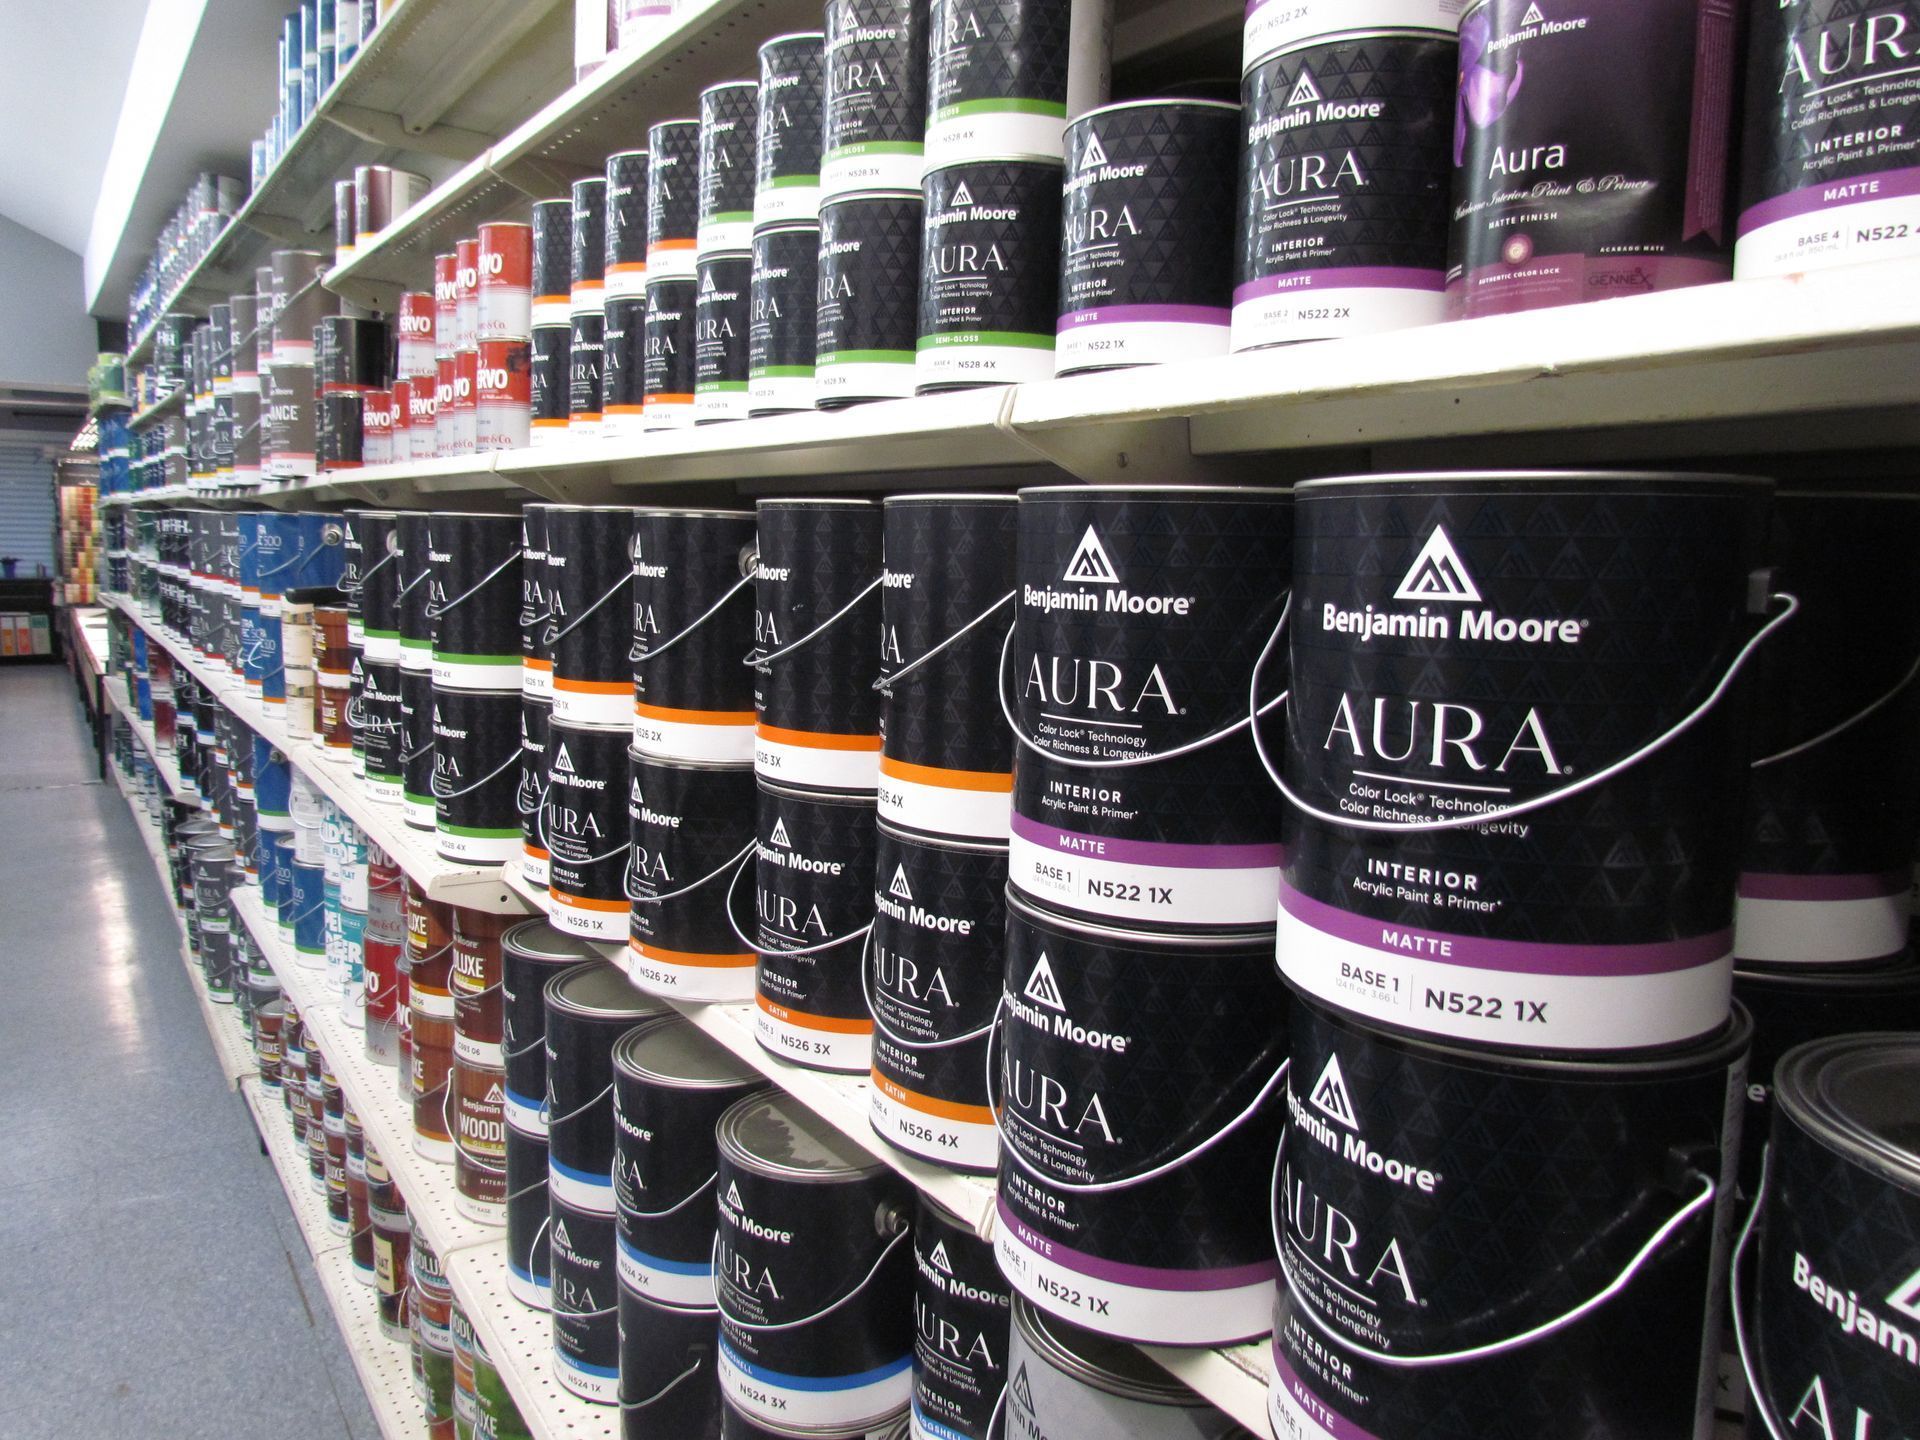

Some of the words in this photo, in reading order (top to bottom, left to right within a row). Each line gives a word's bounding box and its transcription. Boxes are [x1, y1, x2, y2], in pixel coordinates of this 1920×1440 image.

[856, 28, 896, 43] Moore
[1488, 27, 1537, 53] Benjamin
[1541, 18, 1586, 36] Moore
[1778, 13, 1920, 94] AUR
[1799, 100, 1825, 114] Color
[1827, 90, 1853, 105] Lock
[1818, 103, 1865, 121] Richness
[1249, 109, 1310, 144] Benjamin
[1316, 103, 1380, 122] Moore
[1813, 125, 1903, 154] INTERIOR
[1489, 145, 1564, 180] Aura
[1802, 156, 1835, 171] Acrylic
[1837, 147, 1863, 162] Paint
[1100, 164, 1145, 182] Moore
[1251, 151, 1364, 200] AURA
[1486, 190, 1529, 208] Interior
[1531, 180, 1572, 199] Paint
[1597, 174, 1649, 192] Primer
[1824, 180, 1880, 202] MATTE
[970, 207, 1017, 220] Moore
[1300, 203, 1341, 215] Technology
[1310, 213, 1348, 226] Longevity
[1488, 217, 1516, 230] MATTE
[1520, 211, 1558, 223] FINISH
[1062, 205, 1138, 251] AURA
[1798, 231, 1829, 247] BASE
[1856, 224, 1908, 243] N522
[1272, 237, 1324, 253] INTERIOR
[1600, 245, 1640, 253] ACABADO
[1643, 244, 1664, 252] MATE
[926, 244, 1004, 278] AURA
[1072, 279, 1107, 292] INTERIOR
[1278, 276, 1312, 288] MATTE
[1478, 272, 1512, 285] AUTHENTIC
[1513, 269, 1537, 279] COLOR
[1539, 267, 1560, 275] LOCK
[711, 291, 737, 303] Moore
[655, 311, 681, 322] Moore
[940, 307, 976, 316] INTERIOR
[1075, 312, 1098, 323] MATTE
[1298, 309, 1329, 320] N522
[1334, 307, 1350, 318] 2X
[935, 335, 979, 345] SEMI-GLOSS
[1088, 341, 1111, 351] N522
[958, 361, 980, 369] N528
[984, 361, 996, 369] 4X
[640, 563, 666, 578] Moore
[1024, 584, 1098, 614] Benjamin
[1105, 589, 1189, 615] Moore
[1322, 602, 1448, 642] Benjamin
[1459, 610, 1581, 643] Moore
[1025, 653, 1179, 715] AURA
[650, 729, 662, 743] 2X
[1033, 735, 1051, 748] Color
[1053, 738, 1090, 755] Richness
[1038, 722, 1057, 736] Color
[1059, 726, 1080, 738] Lock
[1088, 731, 1147, 748] Technology
[1323, 693, 1563, 775] AURA
[770, 755, 782, 768] 3X
[569, 776, 605, 791] Moore
[1050, 781, 1121, 803] INTERIOR
[1349, 783, 1380, 799] Color
[1384, 789, 1416, 805] Lock
[891, 793, 904, 809] 4X
[1041, 796, 1066, 810] Acrylic
[1068, 801, 1089, 815] Paint
[1101, 805, 1134, 820] Primer
[1339, 798, 1369, 815] Color
[1373, 803, 1431, 824] Richness
[641, 809, 680, 828] Moore
[1059, 834, 1106, 855] MATTE
[788, 851, 841, 876] Moore
[1368, 858, 1478, 890] INTERIOR
[1035, 862, 1063, 881] BASE
[1087, 879, 1141, 902] N522
[1149, 887, 1173, 905] 1X
[1353, 877, 1393, 897] Acrylic
[1397, 887, 1429, 904] Paint
[1448, 895, 1496, 913] Primer
[567, 915, 589, 930] N526
[592, 918, 604, 931] 1X
[909, 905, 971, 936] Moore
[1382, 930, 1452, 957] MATTE
[639, 966, 661, 983] N526
[663, 972, 678, 986] 2X
[763, 967, 798, 989] INTERIOR
[1340, 963, 1386, 988] BASE
[1425, 987, 1502, 1020] N522
[1514, 1000, 1548, 1024] 1X
[768, 1004, 788, 1020] SATIN
[897, 1007, 934, 1028] Technology
[906, 1023, 940, 1040] Longevity
[1054, 1015, 1126, 1052] Moore
[780, 1034, 809, 1052] N526
[814, 1042, 831, 1056] 3X
[879, 1039, 918, 1067] INTERIOR
[884, 1082, 906, 1101] SATIN
[1001, 1048, 1116, 1143] AURA
[463, 1097, 501, 1114] Benjamin
[620, 1116, 652, 1142] Moore
[900, 1119, 933, 1142] N526
[938, 1133, 959, 1149] 4X
[1019, 1125, 1035, 1143] Lock
[1039, 1138, 1087, 1167] Technology
[1050, 1157, 1095, 1183] Longevity
[1343, 1133, 1434, 1192] Moore
[1012, 1171, 1066, 1213] INTERIOR
[1024, 1196, 1040, 1215] Paint
[741, 1215, 791, 1244] Moore
[1018, 1225, 1052, 1256] MATTE
[1281, 1162, 1418, 1305] AURA
[567, 1247, 600, 1270] Moore
[637, 1272, 650, 1287] 2X
[1003, 1240, 1021, 1268] BASE
[1038, 1274, 1081, 1307] N522
[1088, 1295, 1110, 1316] 1X
[950, 1279, 1010, 1307] Moore
[1322, 1281, 1381, 1328] Technology
[1335, 1309, 1391, 1349] Longevity
[1290, 1315, 1352, 1380] INTERIOR
[1302, 1351, 1321, 1375] Paint
[567, 1372, 589, 1391] N524
[590, 1380, 602, 1393] 1X
[949, 1374, 982, 1396] Longevity
[739, 1383, 766, 1404] N524
[771, 1396, 787, 1410] 3X
[919, 1381, 962, 1414] INTERIOR
[1294, 1381, 1335, 1429] MATTE
[1276, 1394, 1296, 1431] BASE
